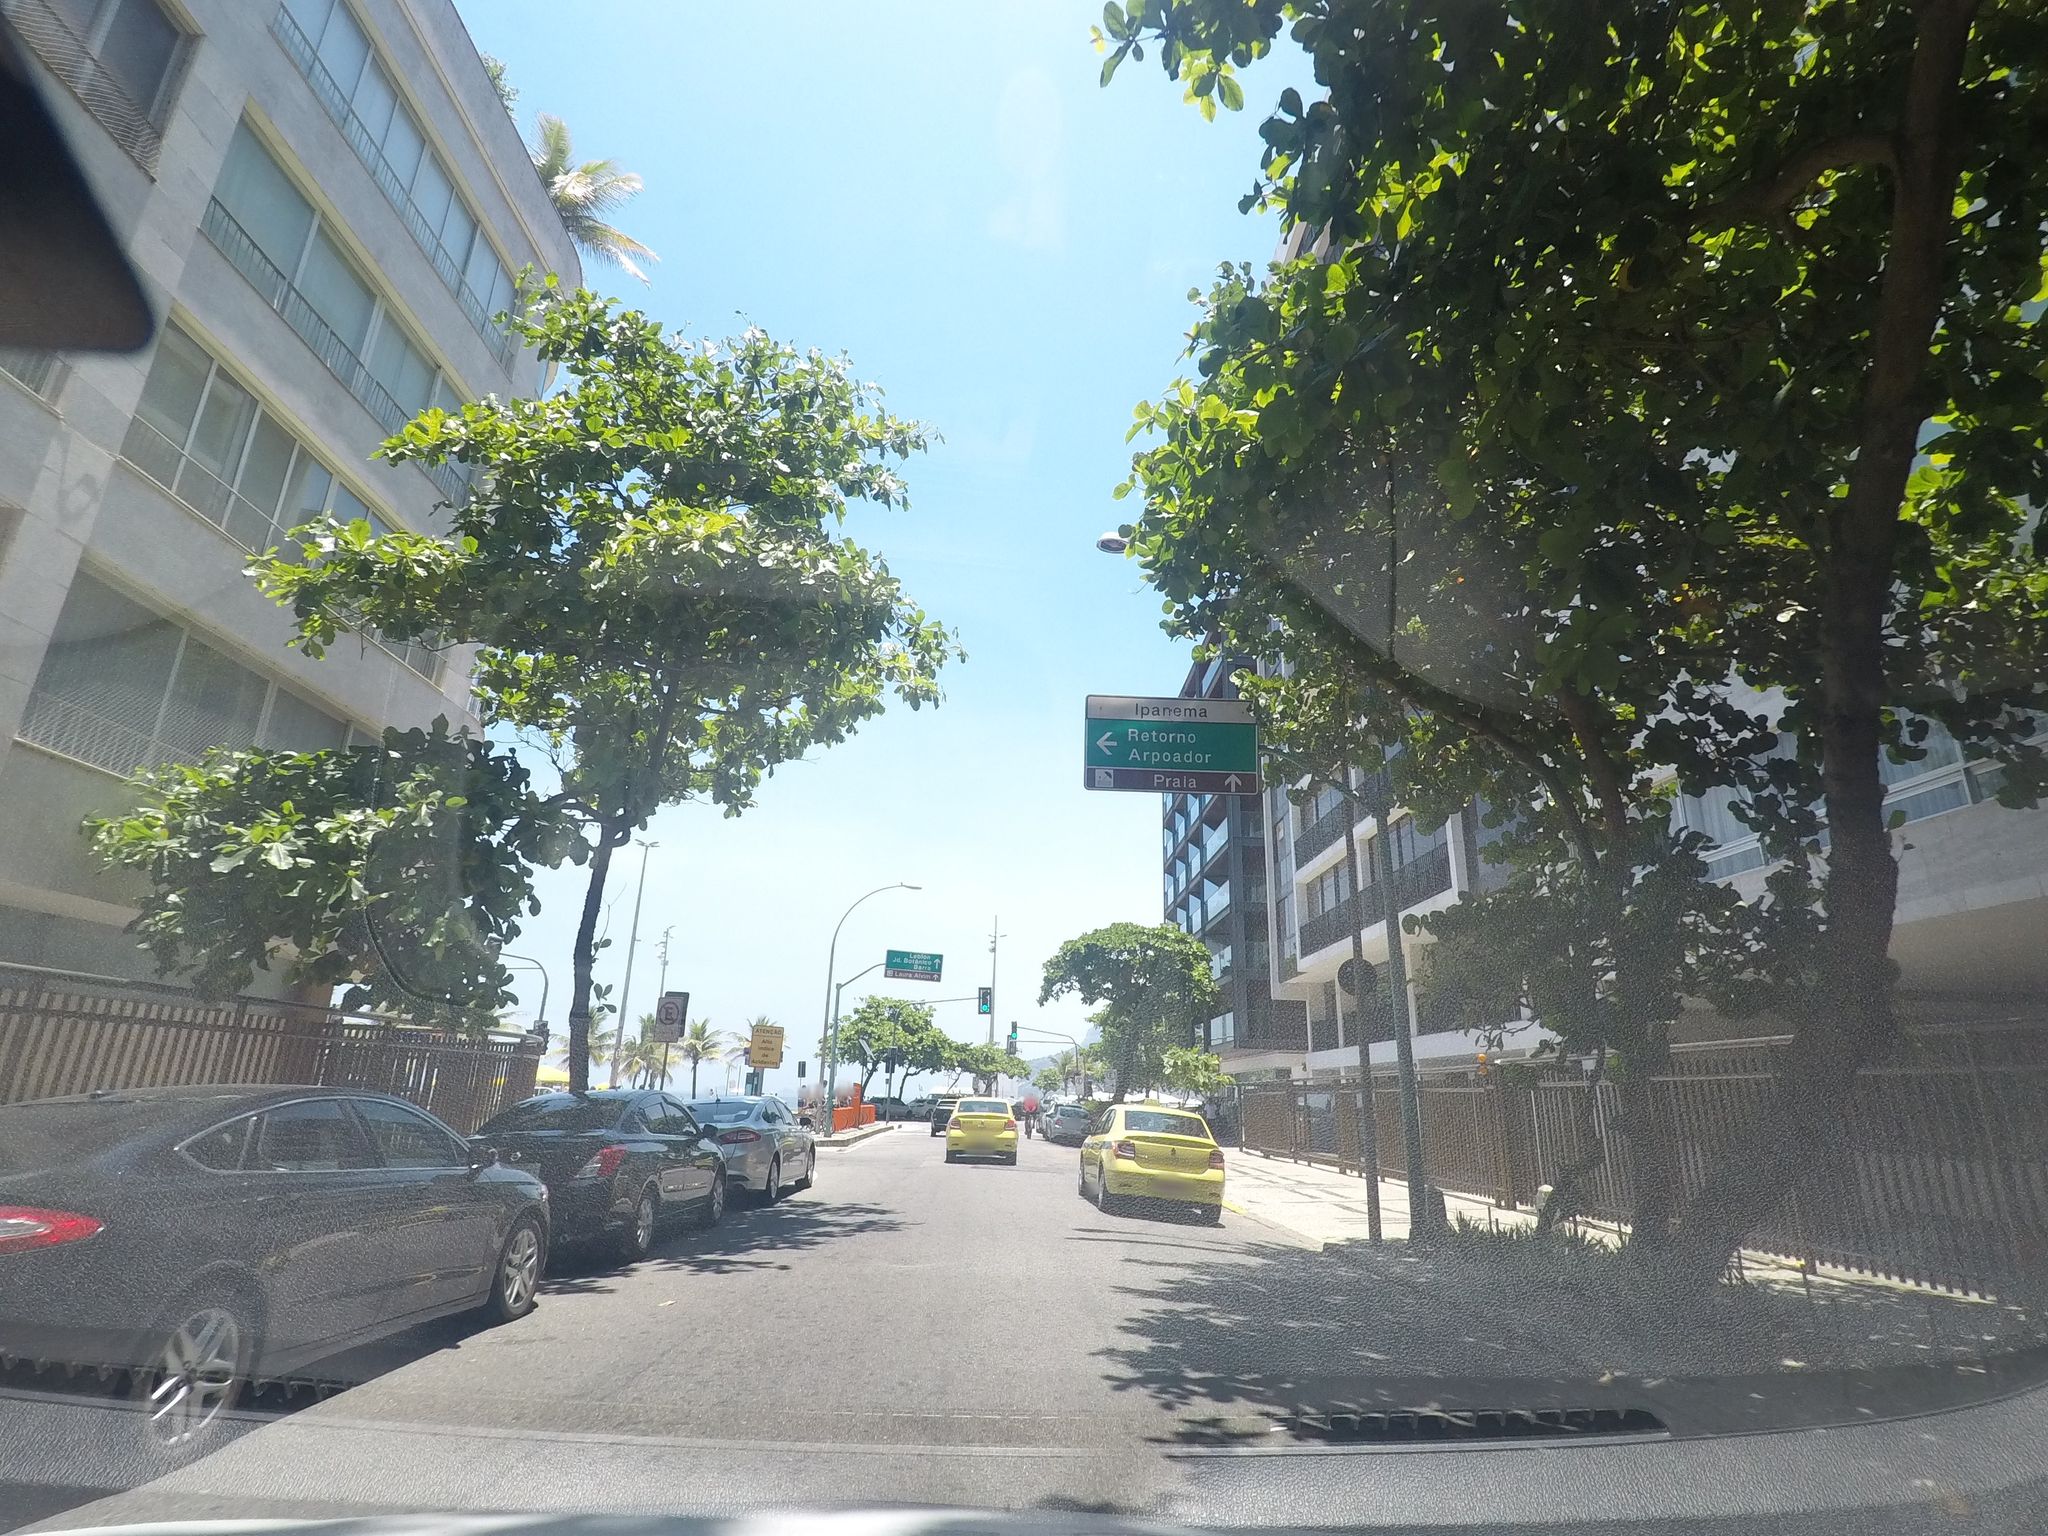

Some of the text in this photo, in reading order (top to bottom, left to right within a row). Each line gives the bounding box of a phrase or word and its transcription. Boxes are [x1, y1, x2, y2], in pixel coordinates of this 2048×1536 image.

[1135, 703, 1208, 719] Ipanema
[1127, 728, 1196, 744] Retorno
[1128, 748, 1212, 764] Arpoador
[1153, 774, 1197, 789] Praia
